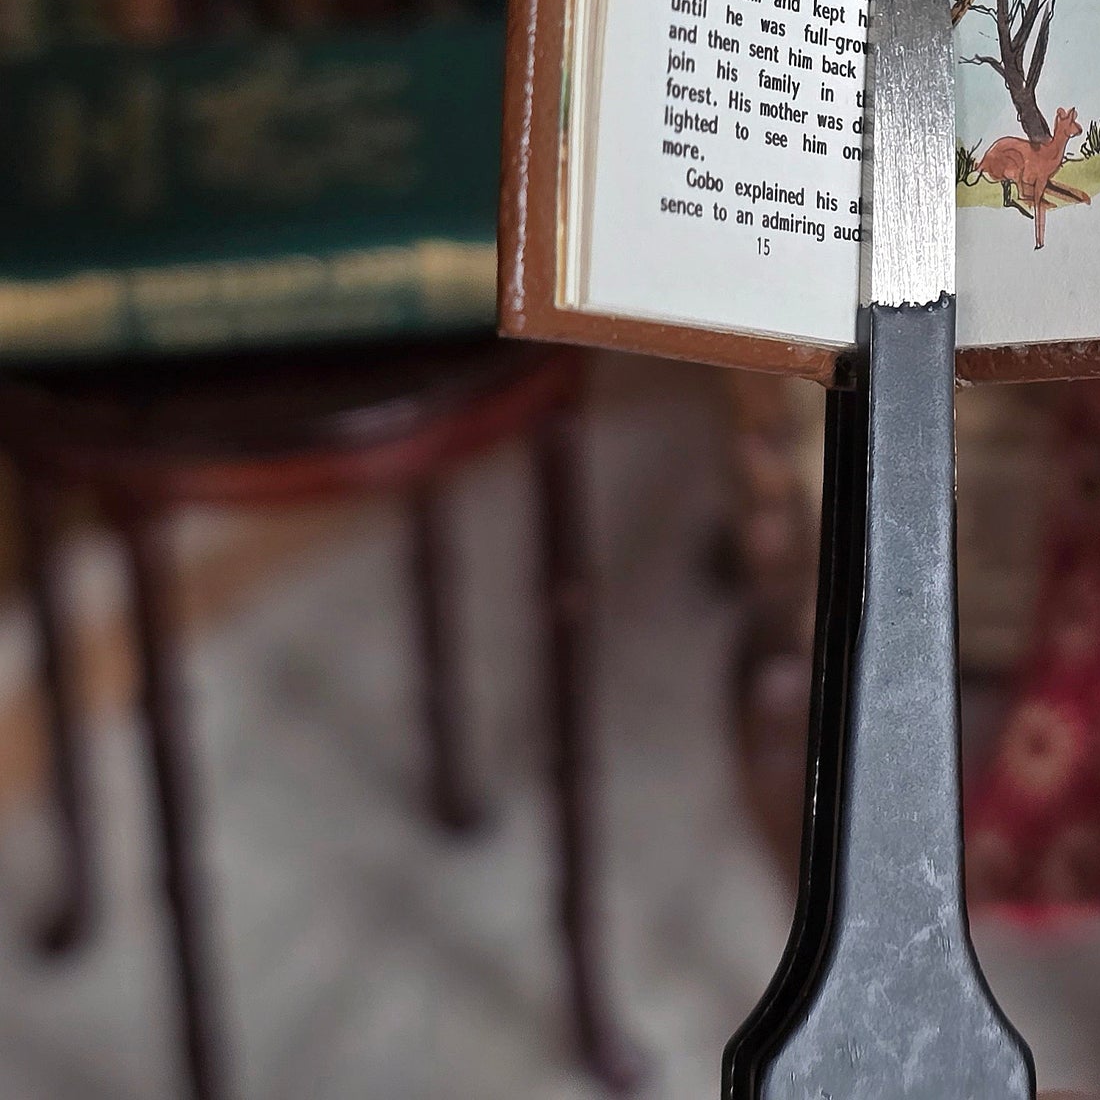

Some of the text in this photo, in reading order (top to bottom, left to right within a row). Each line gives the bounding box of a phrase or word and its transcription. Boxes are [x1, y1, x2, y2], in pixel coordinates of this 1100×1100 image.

[726, 5, 743, 27] he
[760, 17, 786, 37] was
[668, 23, 857, 80] and then sent him back
[667, 48, 696, 74] join
[716, 59, 739, 83] his
[758, 70, 801, 101] family
[820, 83, 834, 103] in
[666, 77, 718, 107] forest.
[728, 90, 751, 113] His
[759, 101, 809, 125] mother
[817, 113, 843, 132] was
[662, 138, 705, 162] more.
[664, 105, 719, 135] lighted
[735, 121, 750, 141] to
[765, 131, 788, 148] see
[802, 134, 828, 156] him
[686, 167, 724, 192] Gobo
[735, 181, 805, 207] explained
[816, 190, 838, 212] his
[660, 196, 863, 242] sence to an admiring aud
[757, 237, 771, 256] 15
